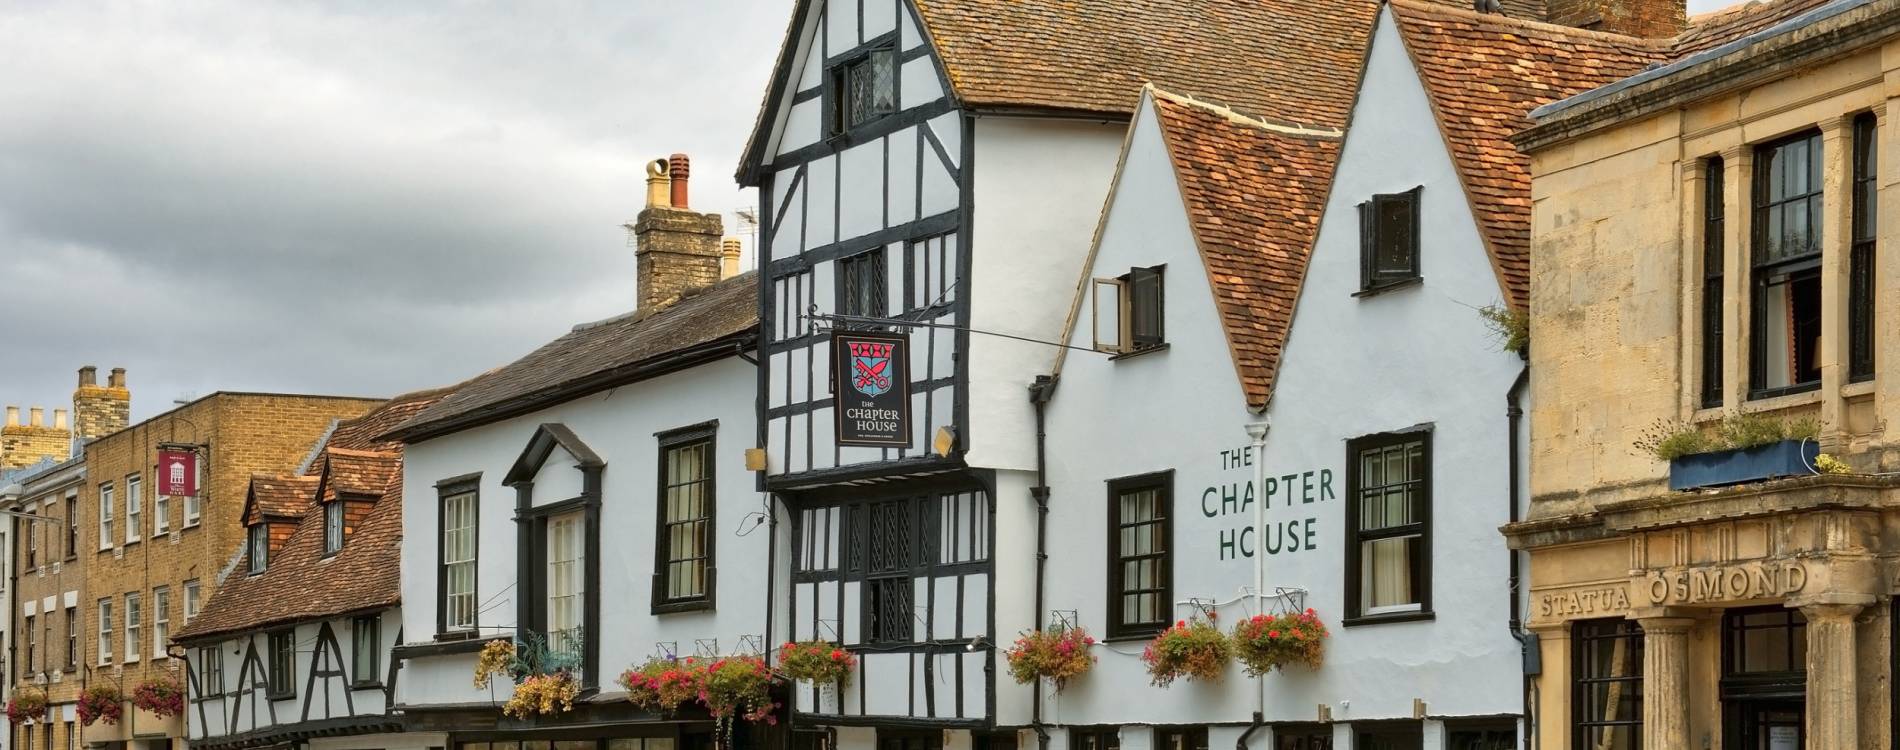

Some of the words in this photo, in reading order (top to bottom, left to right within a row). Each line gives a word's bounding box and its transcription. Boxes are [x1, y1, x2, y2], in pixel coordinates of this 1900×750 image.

[1220, 446, 1252, 470] THE
[1201, 468, 1336, 518] CHAPTER
[1219, 517, 1317, 561] HOUSE
[1541, 587, 1631, 617] STATUA
[1650, 560, 1807, 604] OSMOND
